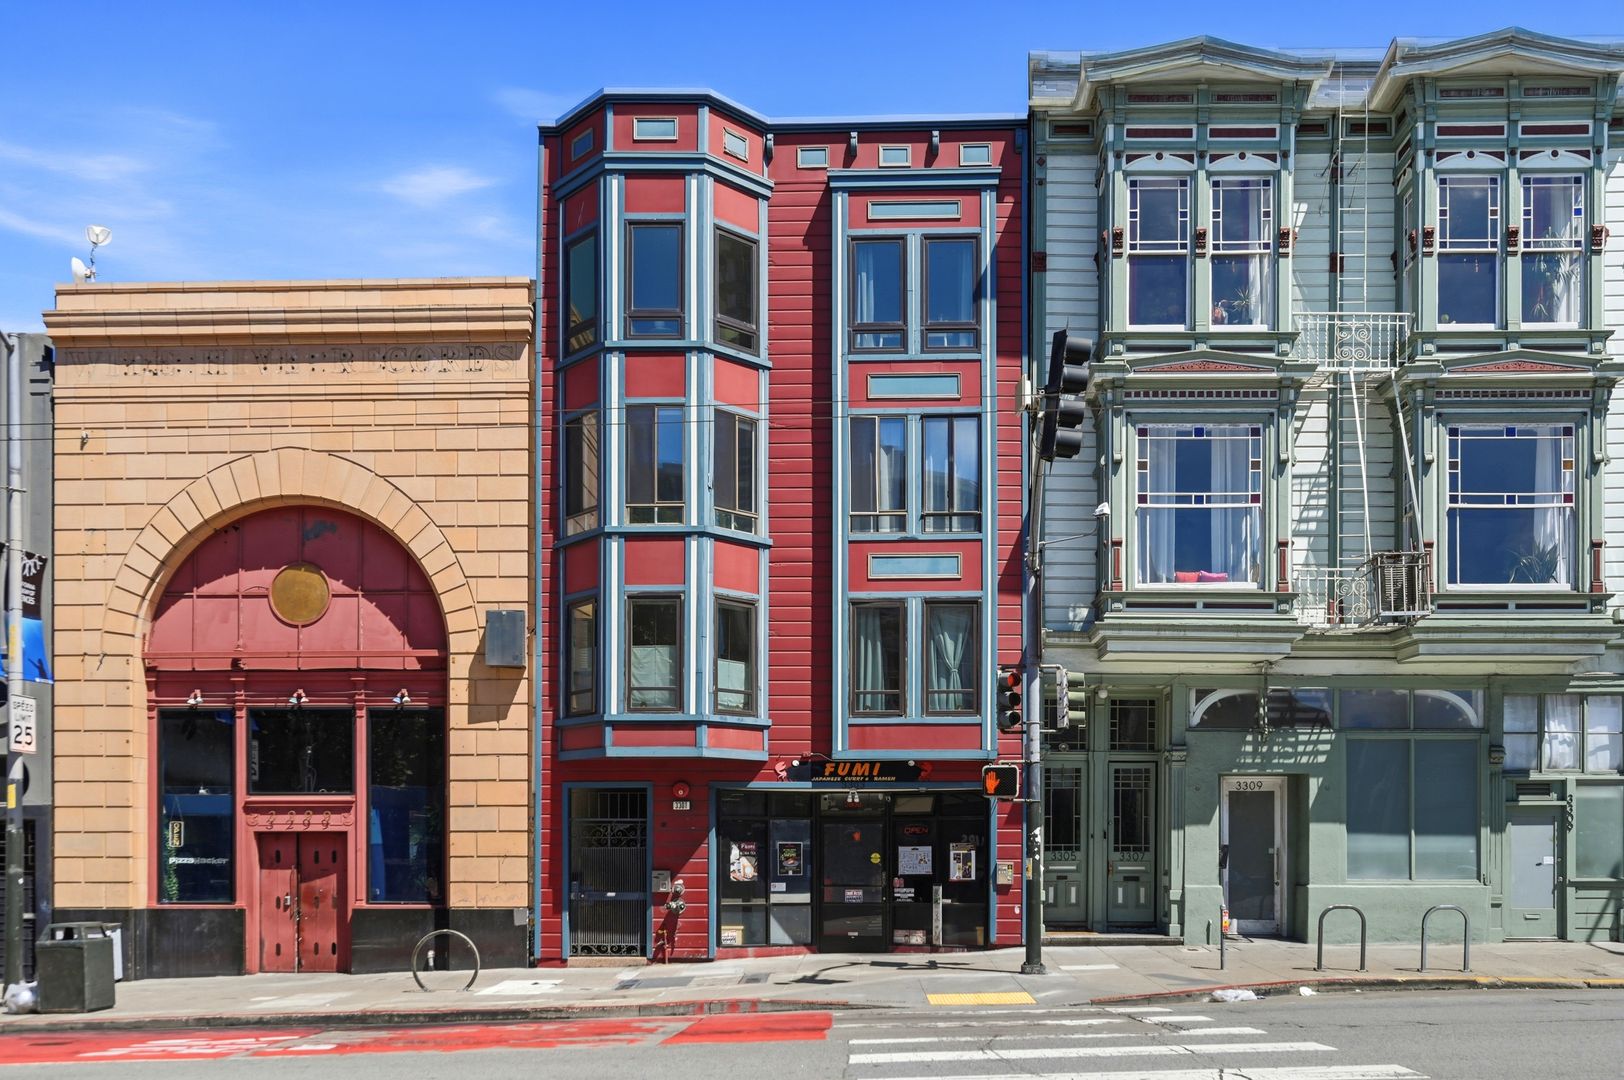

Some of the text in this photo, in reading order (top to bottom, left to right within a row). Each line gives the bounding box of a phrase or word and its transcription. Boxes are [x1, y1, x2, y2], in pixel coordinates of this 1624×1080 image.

[13, 701, 34, 713] SPEED
[15, 713, 32, 723] LIMIT
[14, 724, 33, 746] 25
[824, 761, 881, 776] FUMI
[1235, 780, 1263, 791] 3309
[266, 810, 331, 830] 3299
[903, 825, 929, 835] OPEN
[1050, 851, 1077, 861] 3305
[1119, 851, 1145, 861] 3307
